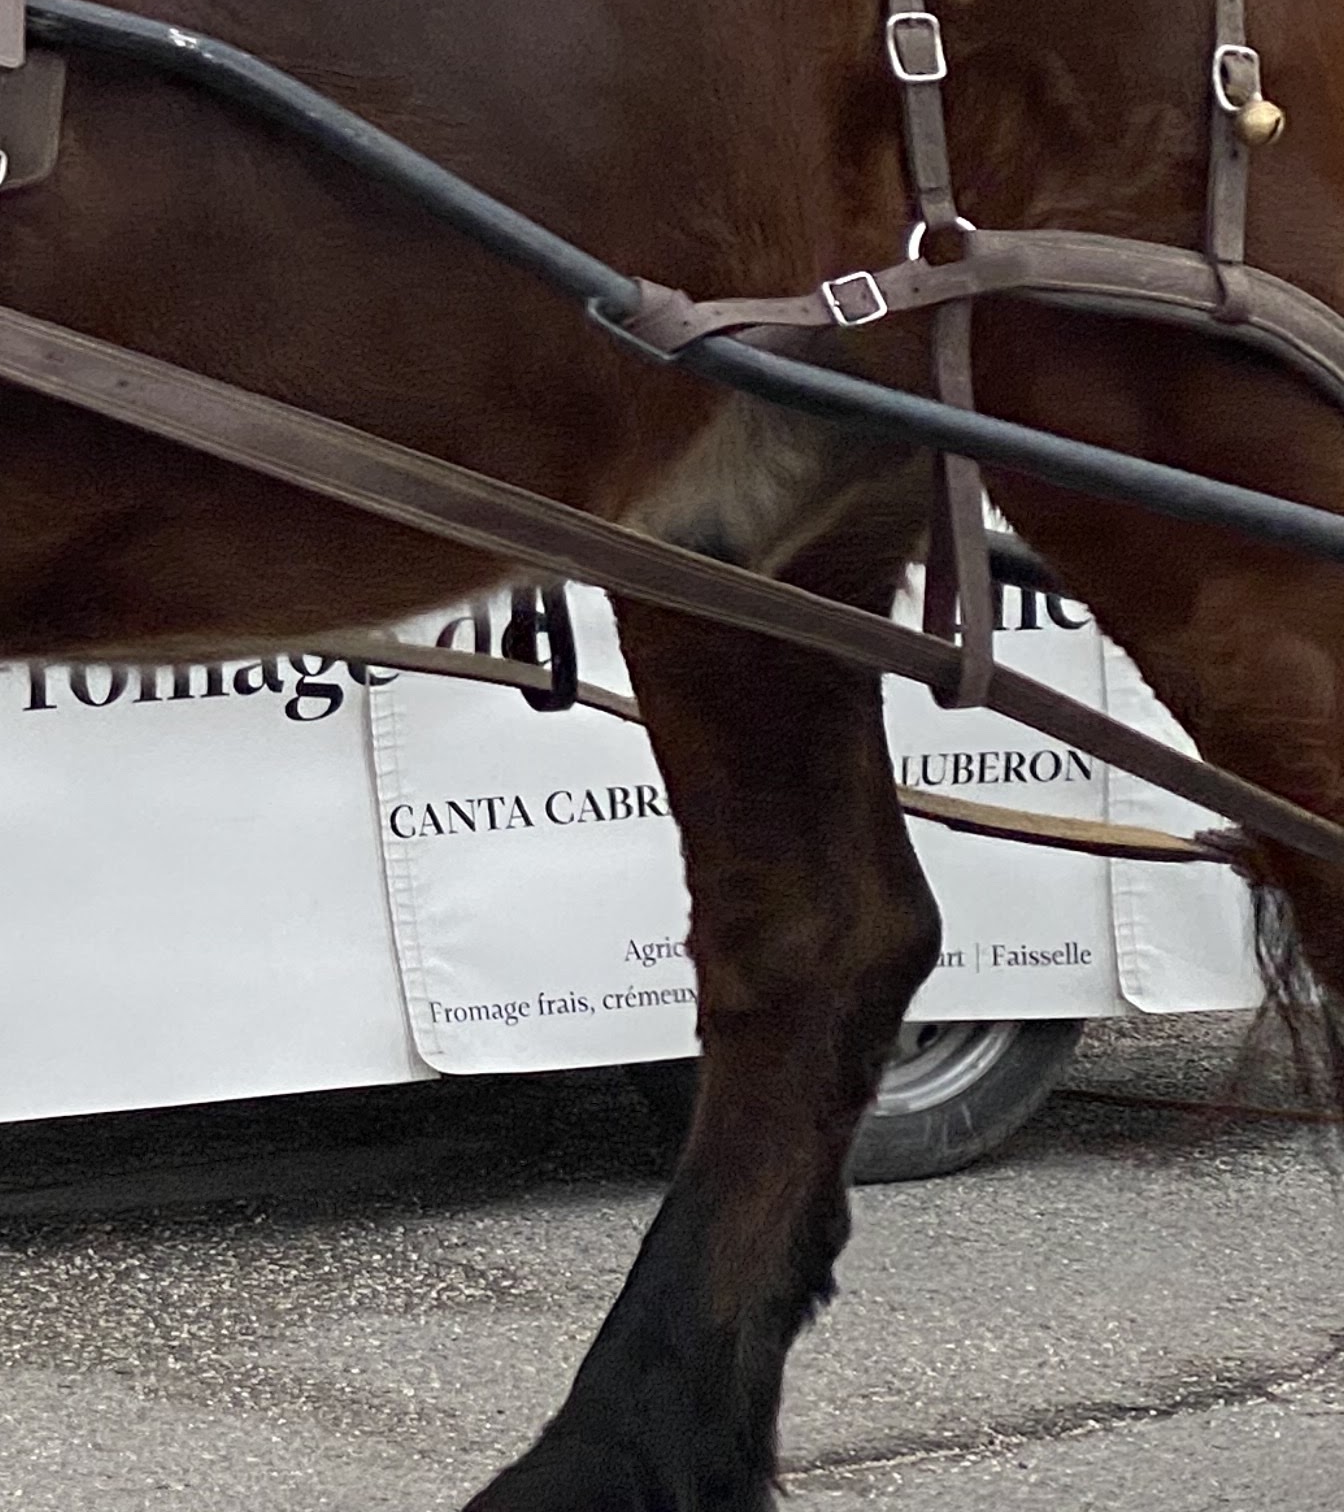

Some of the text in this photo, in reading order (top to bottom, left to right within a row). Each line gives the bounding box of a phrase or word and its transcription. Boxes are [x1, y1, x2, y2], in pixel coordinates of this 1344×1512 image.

[388, 749, 1093, 839] CANTA CABR LUBERON
[429, 1000, 531, 1027] Fromage
[537, 991, 596, 1017] frais,
[992, 942, 1092, 967] Faisselle
[624, 937, 689, 968] Agric
